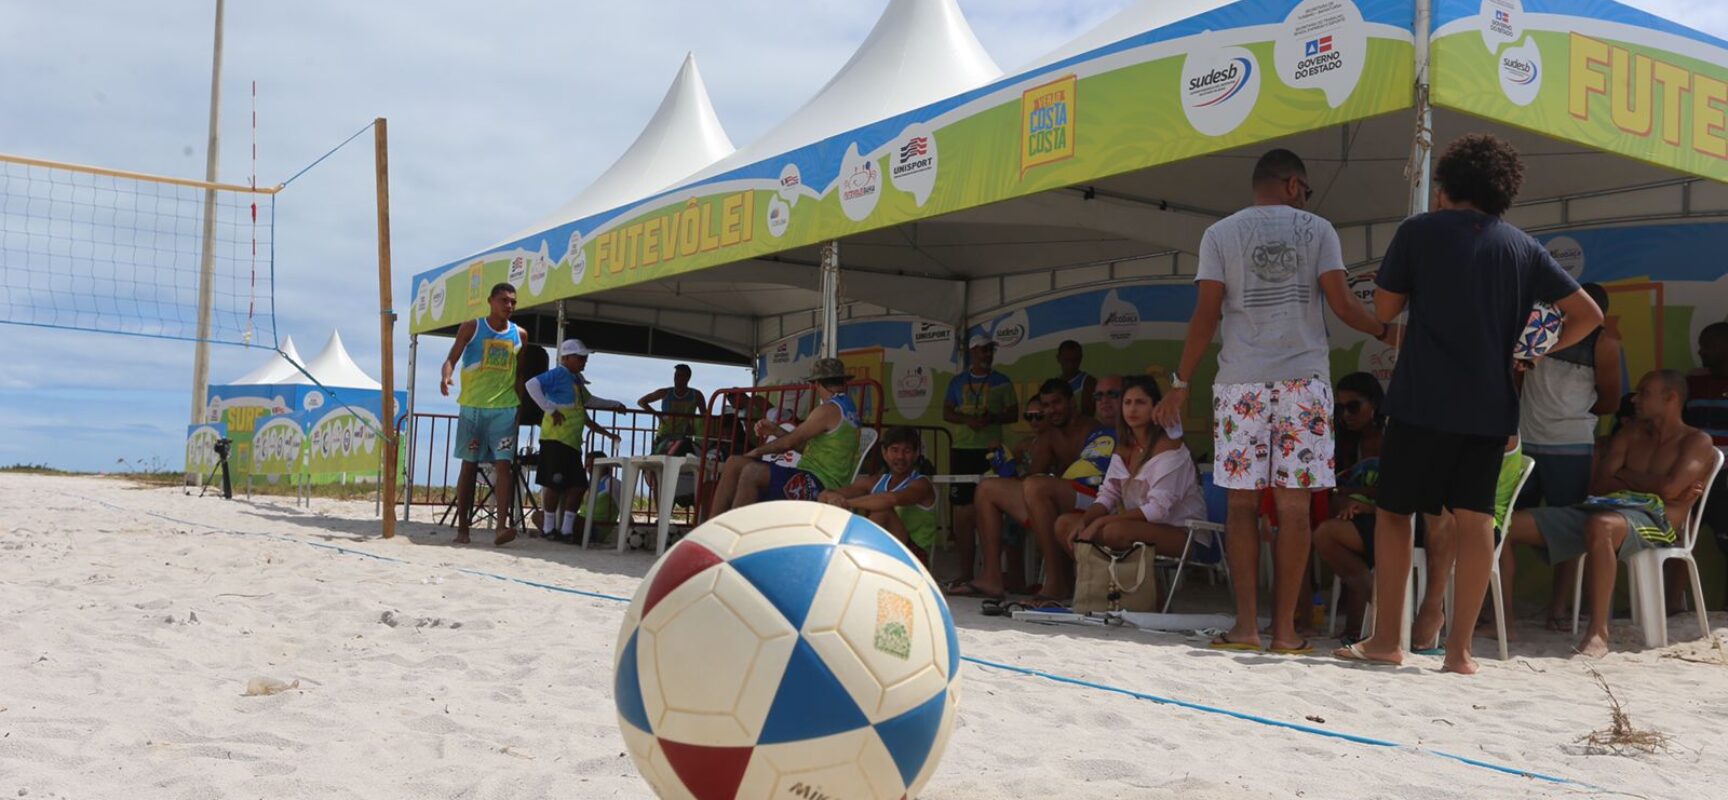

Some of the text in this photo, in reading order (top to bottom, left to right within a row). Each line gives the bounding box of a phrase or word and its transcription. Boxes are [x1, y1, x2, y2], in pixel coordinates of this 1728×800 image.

[1295, 60, 1343, 80] DO ESTADO
[1297, 51, 1340, 70] GOVERNO
[1503, 58, 1531, 73] sudesb
[1189, 63, 1238, 91] sudesb
[1030, 102, 1067, 134] COSTA
[1028, 126, 1066, 157] COSTA
[893, 157, 933, 175] UNISPORT
[593, 189, 755, 279] FUTEVÔLEI
